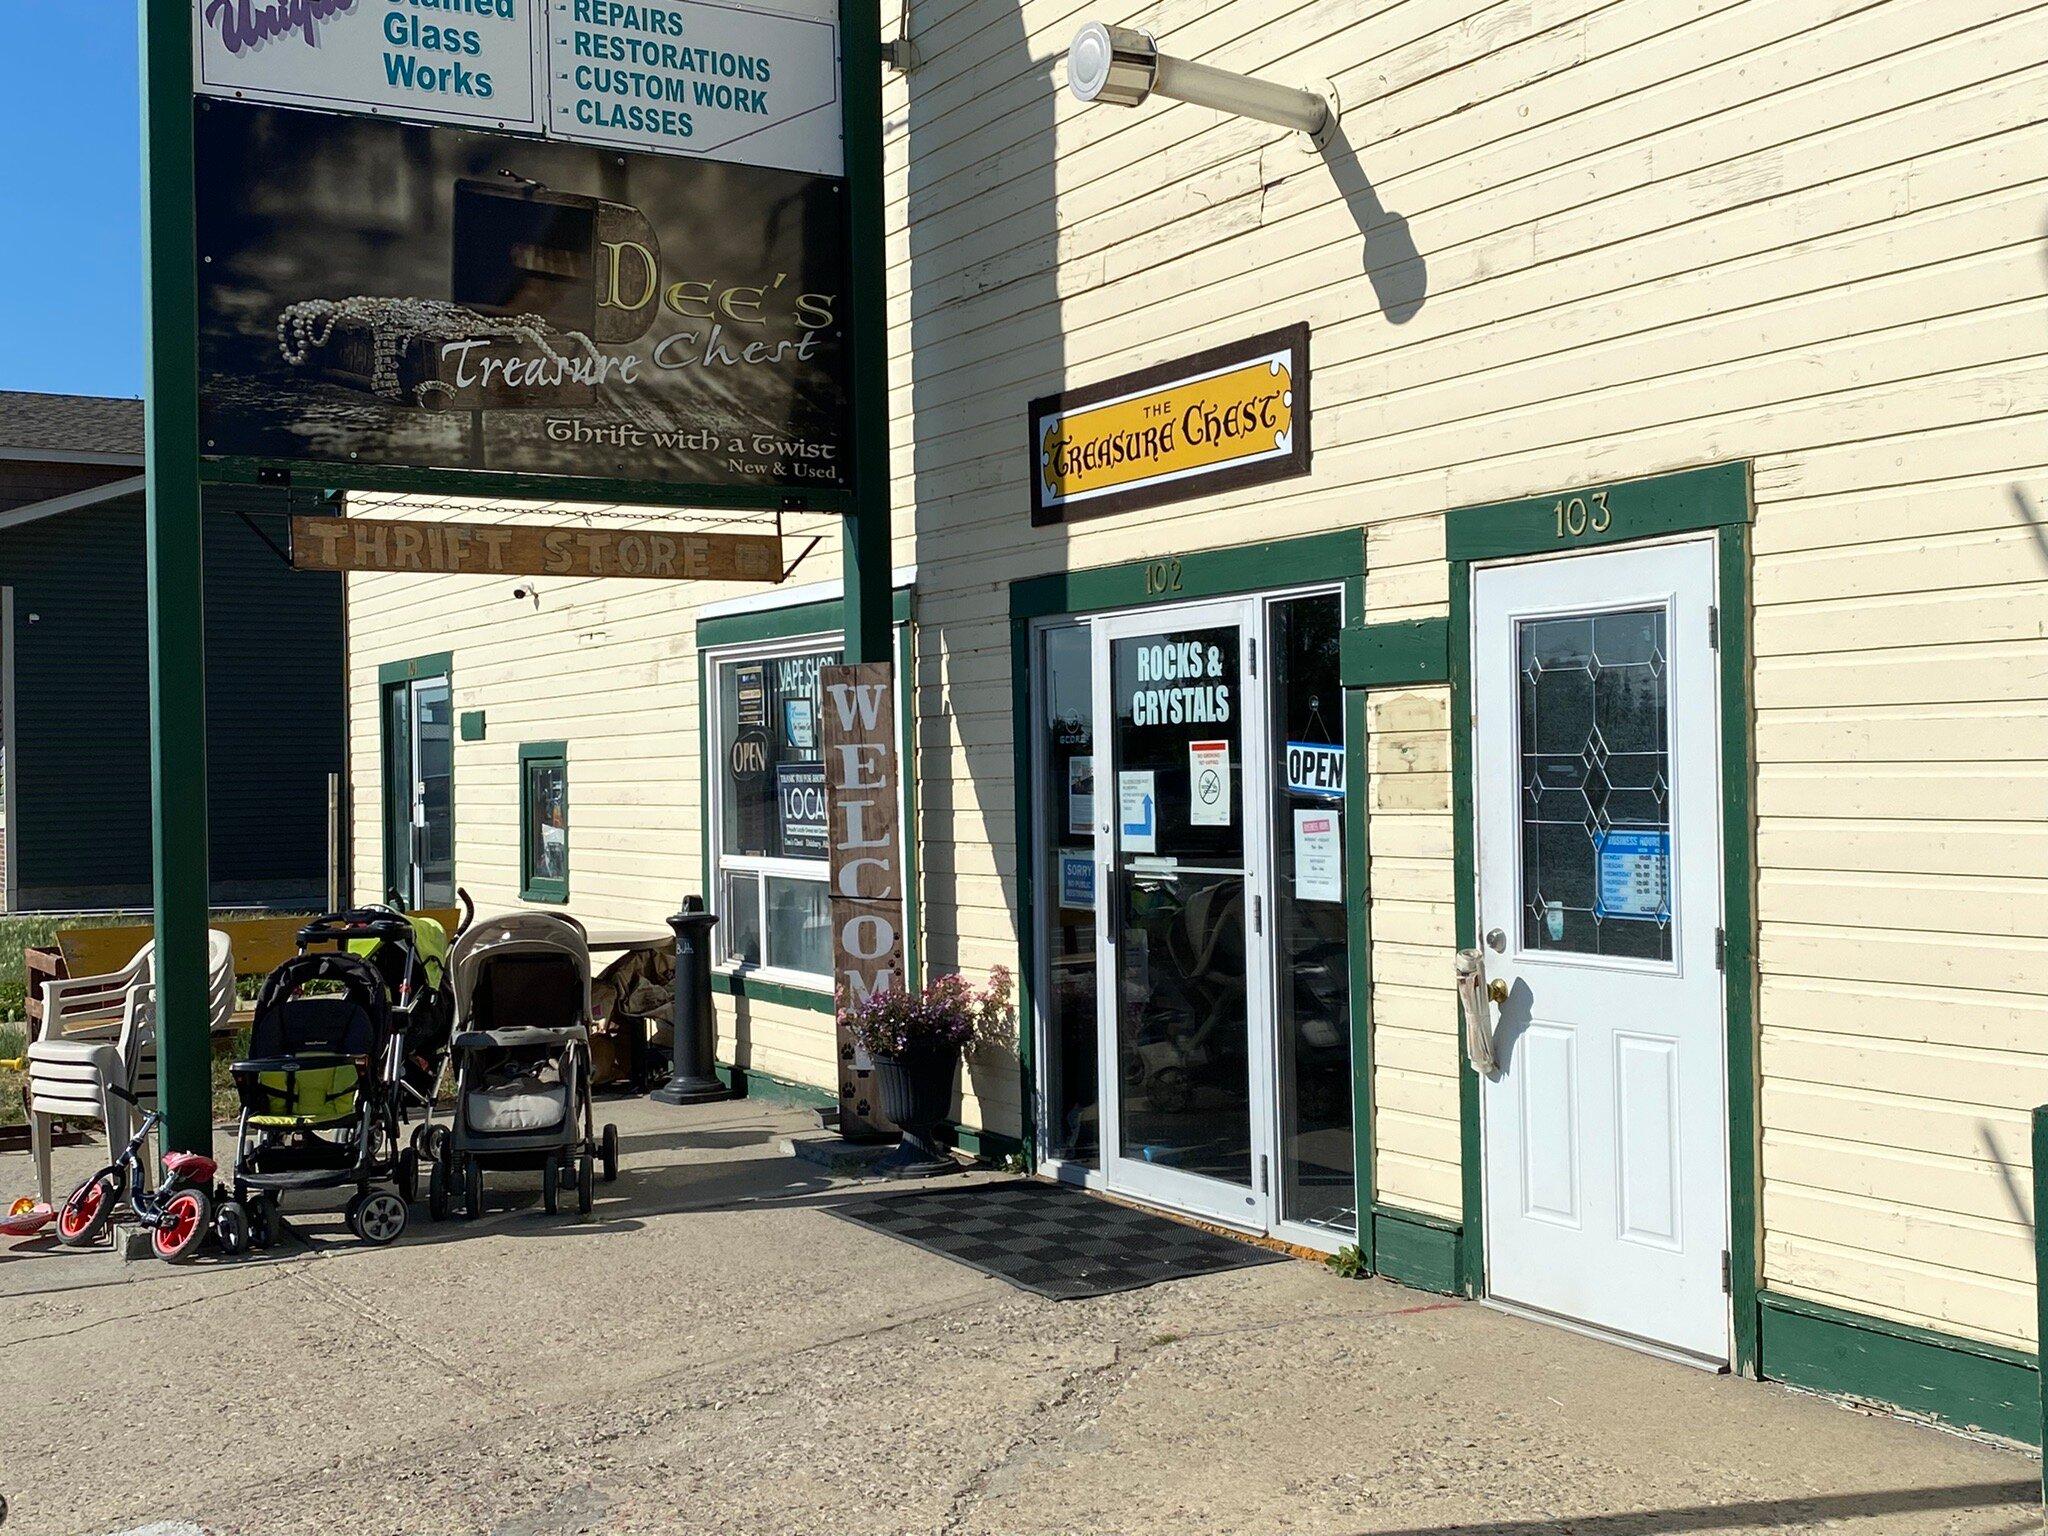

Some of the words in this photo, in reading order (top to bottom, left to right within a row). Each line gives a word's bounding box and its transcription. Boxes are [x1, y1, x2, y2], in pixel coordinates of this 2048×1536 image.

[383, 12, 481, 55] Glass
[574, 0, 683, 36] REPAIRS
[383, 52, 493, 97] Works
[575, 31, 771, 82] RESTORATIONS
[575, 65, 685, 103] CUSTOM
[692, 81, 769, 115] WORK
[576, 99, 693, 137] CLASSES
[441, 338, 643, 389] Treasure
[652, 324, 825, 370] Chest
[1143, 401, 1171, 418] THE
[546, 419, 647, 447] Thrift
[653, 429, 719, 451] with
[727, 439, 746, 453] a
[752, 434, 836, 459] Twist
[729, 459, 768, 475] New
[772, 462, 787, 476] &
[794, 463, 836, 479] Used
[1553, 491, 1611, 538] 103
[308, 523, 513, 570] THRIFT
[541, 531, 710, 577] STORE
[1145, 557, 1183, 595] 102
[778, 659, 804, 693] VAPE
[1138, 641, 1203, 682] ROCKS
[1207, 645, 1223, 677] &
[1133, 685, 1230, 726] CRYSTALS
[733, 741, 766, 773] OPEN
[1289, 749, 1344, 788] OPEN
[783, 787, 826, 820] LOCA
